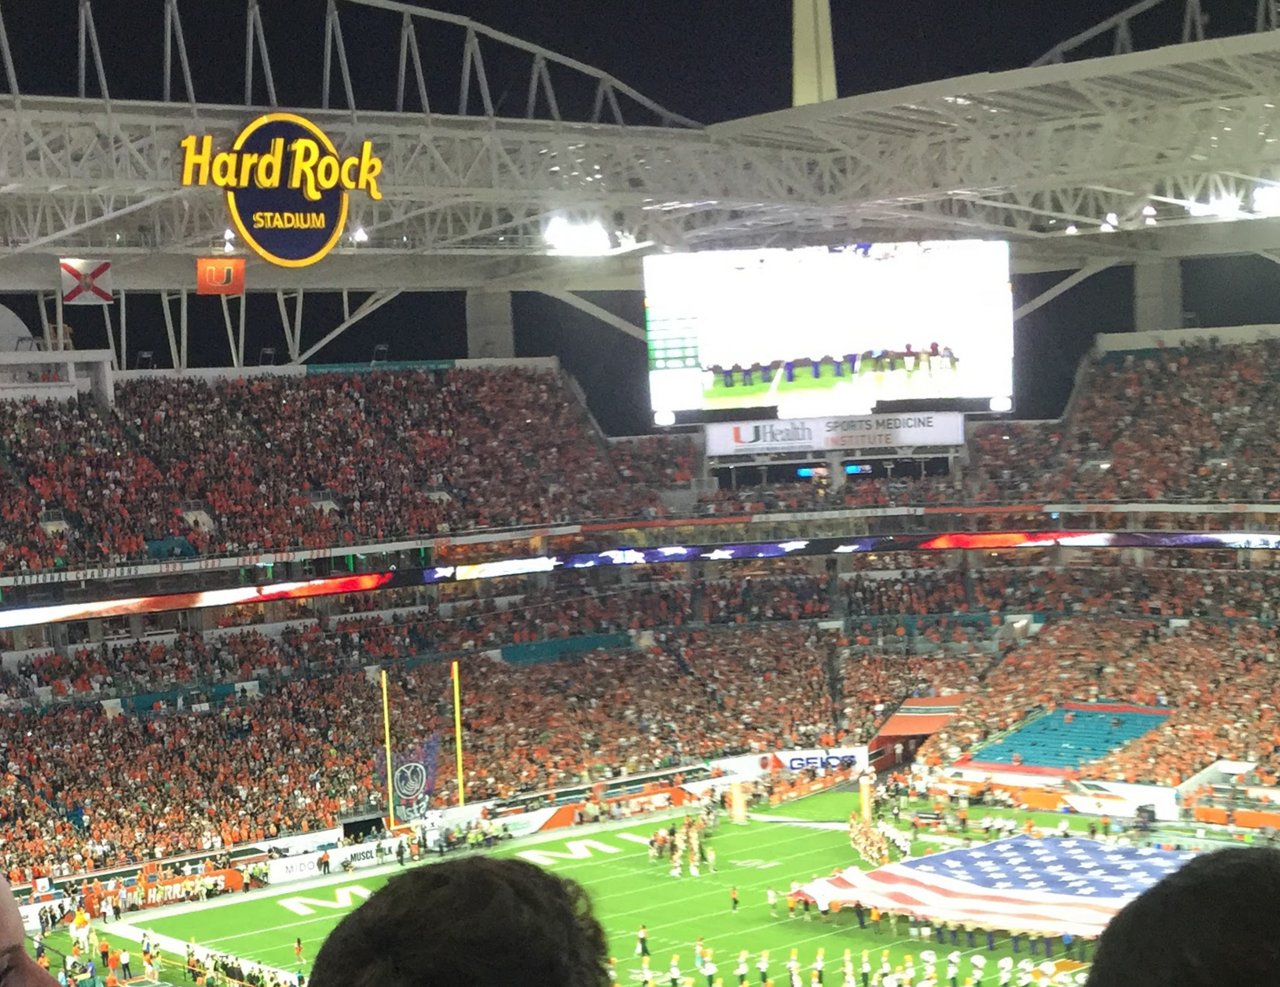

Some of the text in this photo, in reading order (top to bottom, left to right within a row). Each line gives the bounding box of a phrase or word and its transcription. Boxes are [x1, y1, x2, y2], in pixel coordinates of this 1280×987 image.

[181, 135, 383, 200] Hard Rock
[253, 212, 325, 229] STADIUM
[825, 416, 934, 432] SPORTS MEDICINE
[825, 433, 892, 447] INSTITUTE
[13, 566, 139, 585] NATIONAL CHAMPIONS
[350, 848, 378, 863] MUSCL
